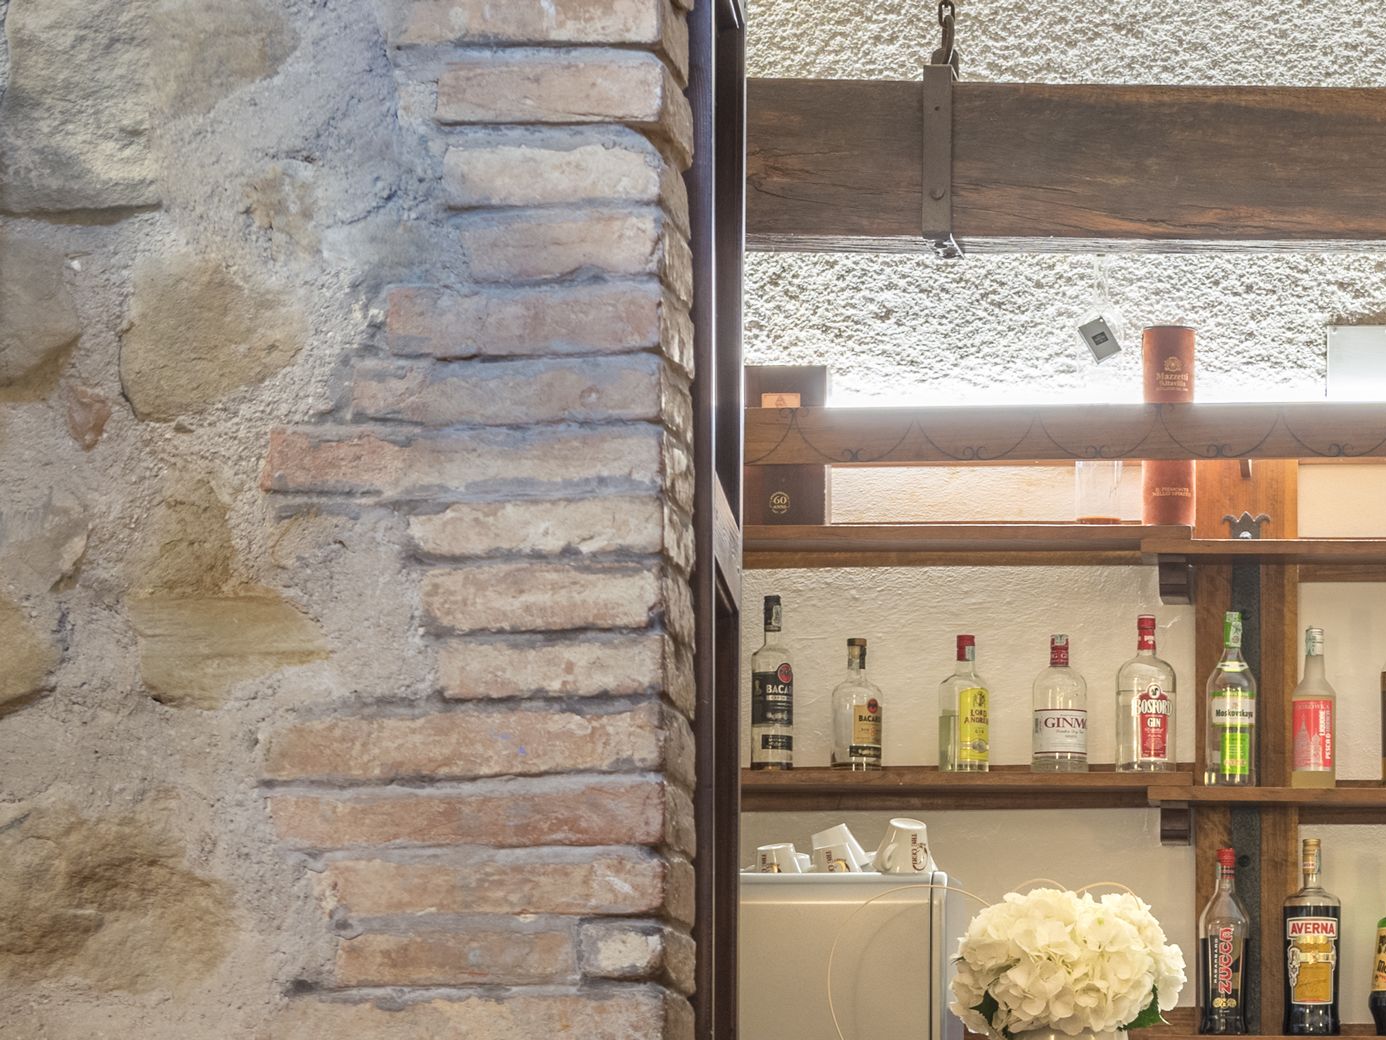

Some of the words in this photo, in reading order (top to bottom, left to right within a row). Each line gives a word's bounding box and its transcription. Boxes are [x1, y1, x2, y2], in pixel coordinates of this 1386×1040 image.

[773, 495, 787, 505] 60
[970, 709, 987, 718] LORD
[1133, 699, 1173, 716] BOSFORD
[1147, 717, 1161, 729] GIN
[1290, 923, 1335, 935] AVERNA
[1219, 927, 1233, 995] ZUCCA
